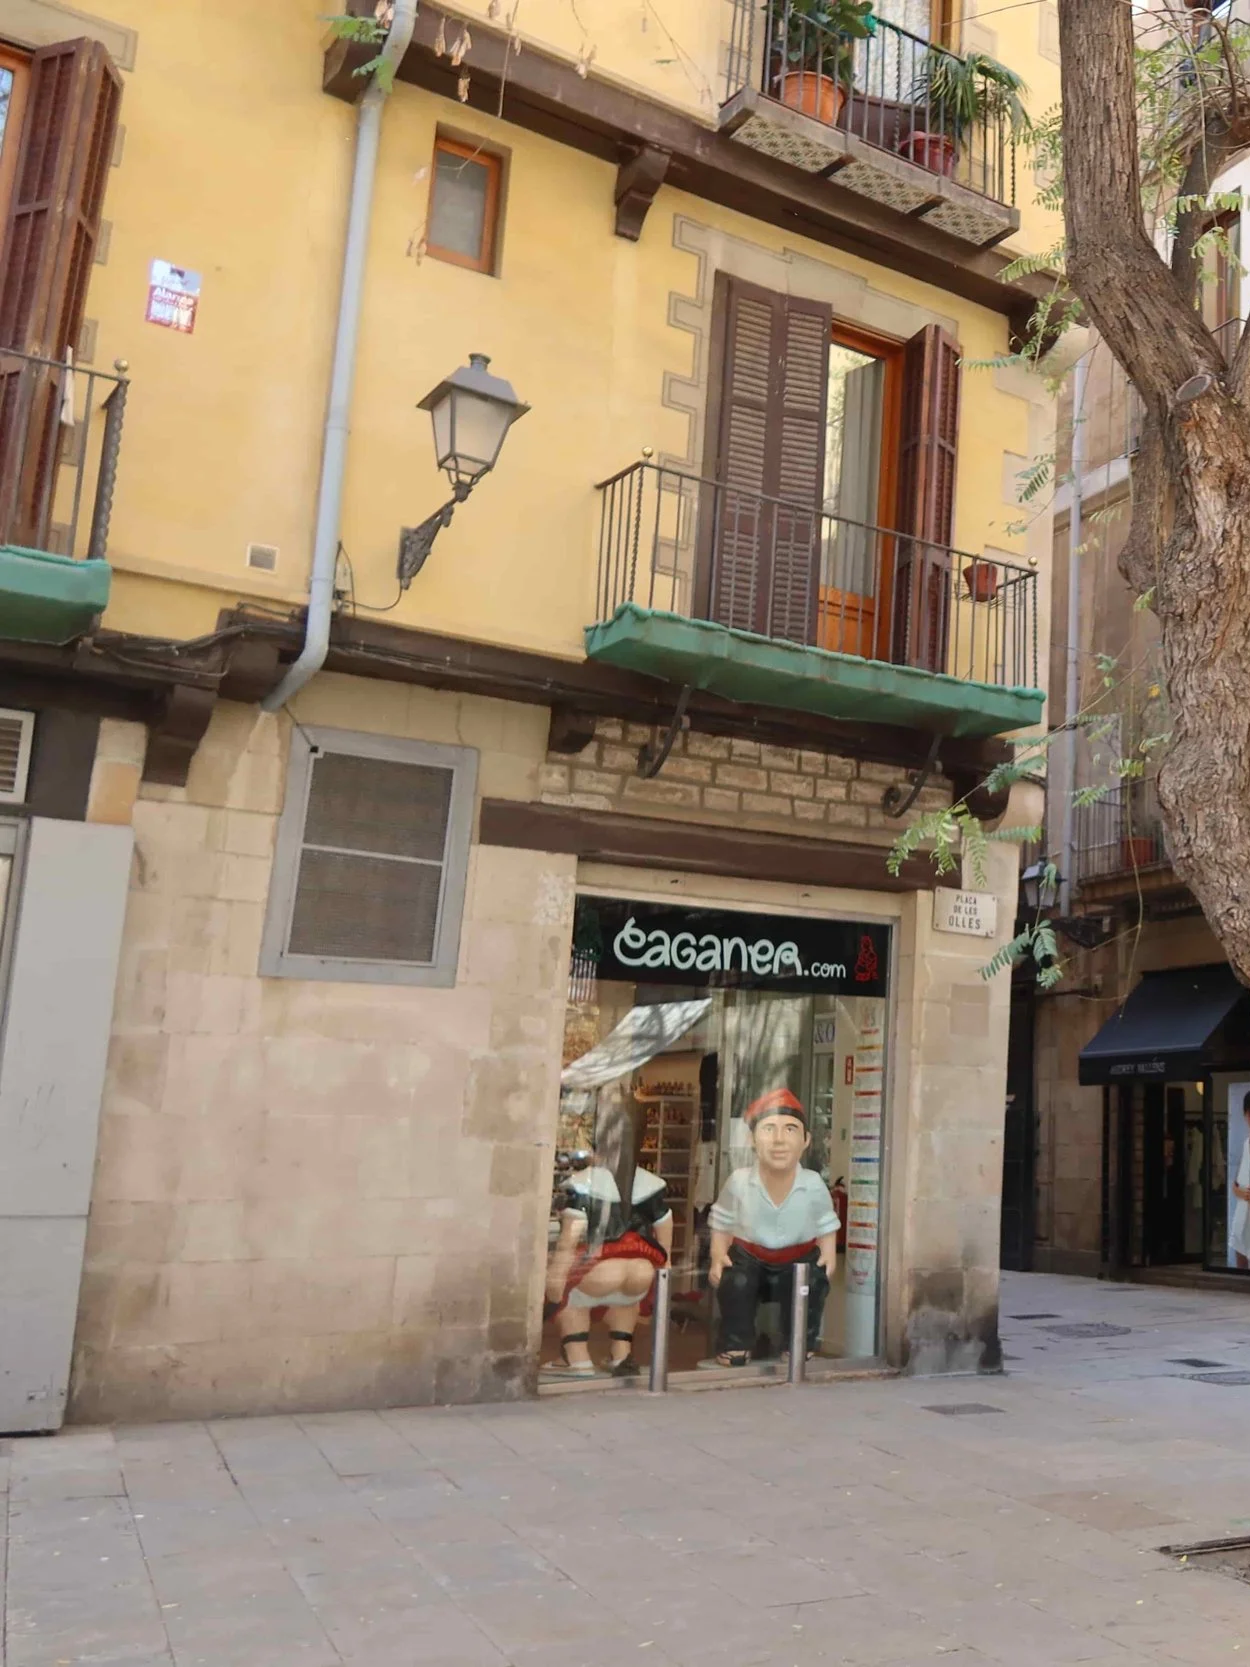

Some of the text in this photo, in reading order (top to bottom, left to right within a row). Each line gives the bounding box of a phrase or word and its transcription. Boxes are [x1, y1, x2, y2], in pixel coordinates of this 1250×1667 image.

[953, 905, 978, 915] DE LES
[948, 915, 981, 930] OLLES
